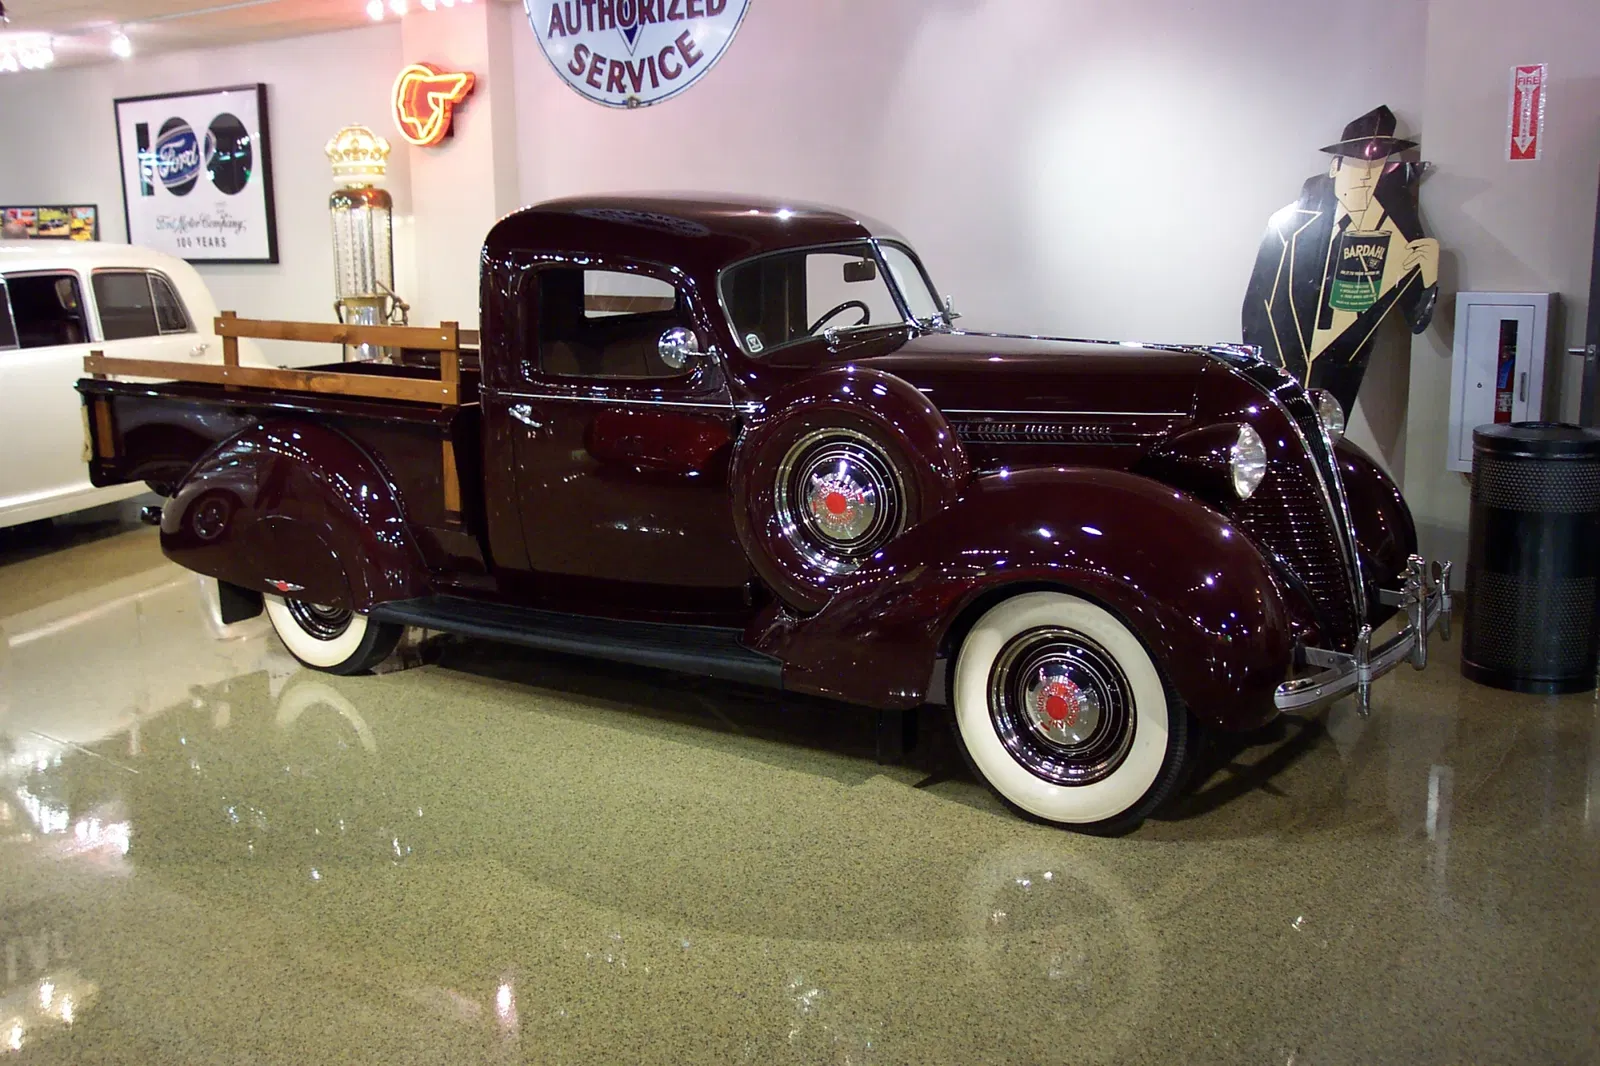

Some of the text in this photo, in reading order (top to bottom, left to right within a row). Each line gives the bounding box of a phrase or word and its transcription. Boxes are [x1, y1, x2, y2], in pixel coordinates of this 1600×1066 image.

[547, 0, 727, 39] AUTHORIZED
[567, 29, 703, 93] SERVICE
[1518, 76, 1540, 85] FIRE
[159, 138, 199, 178] Ford
[176, 236, 227, 248] 100 YEARS
[1343, 244, 1385, 260] BARDAHL
